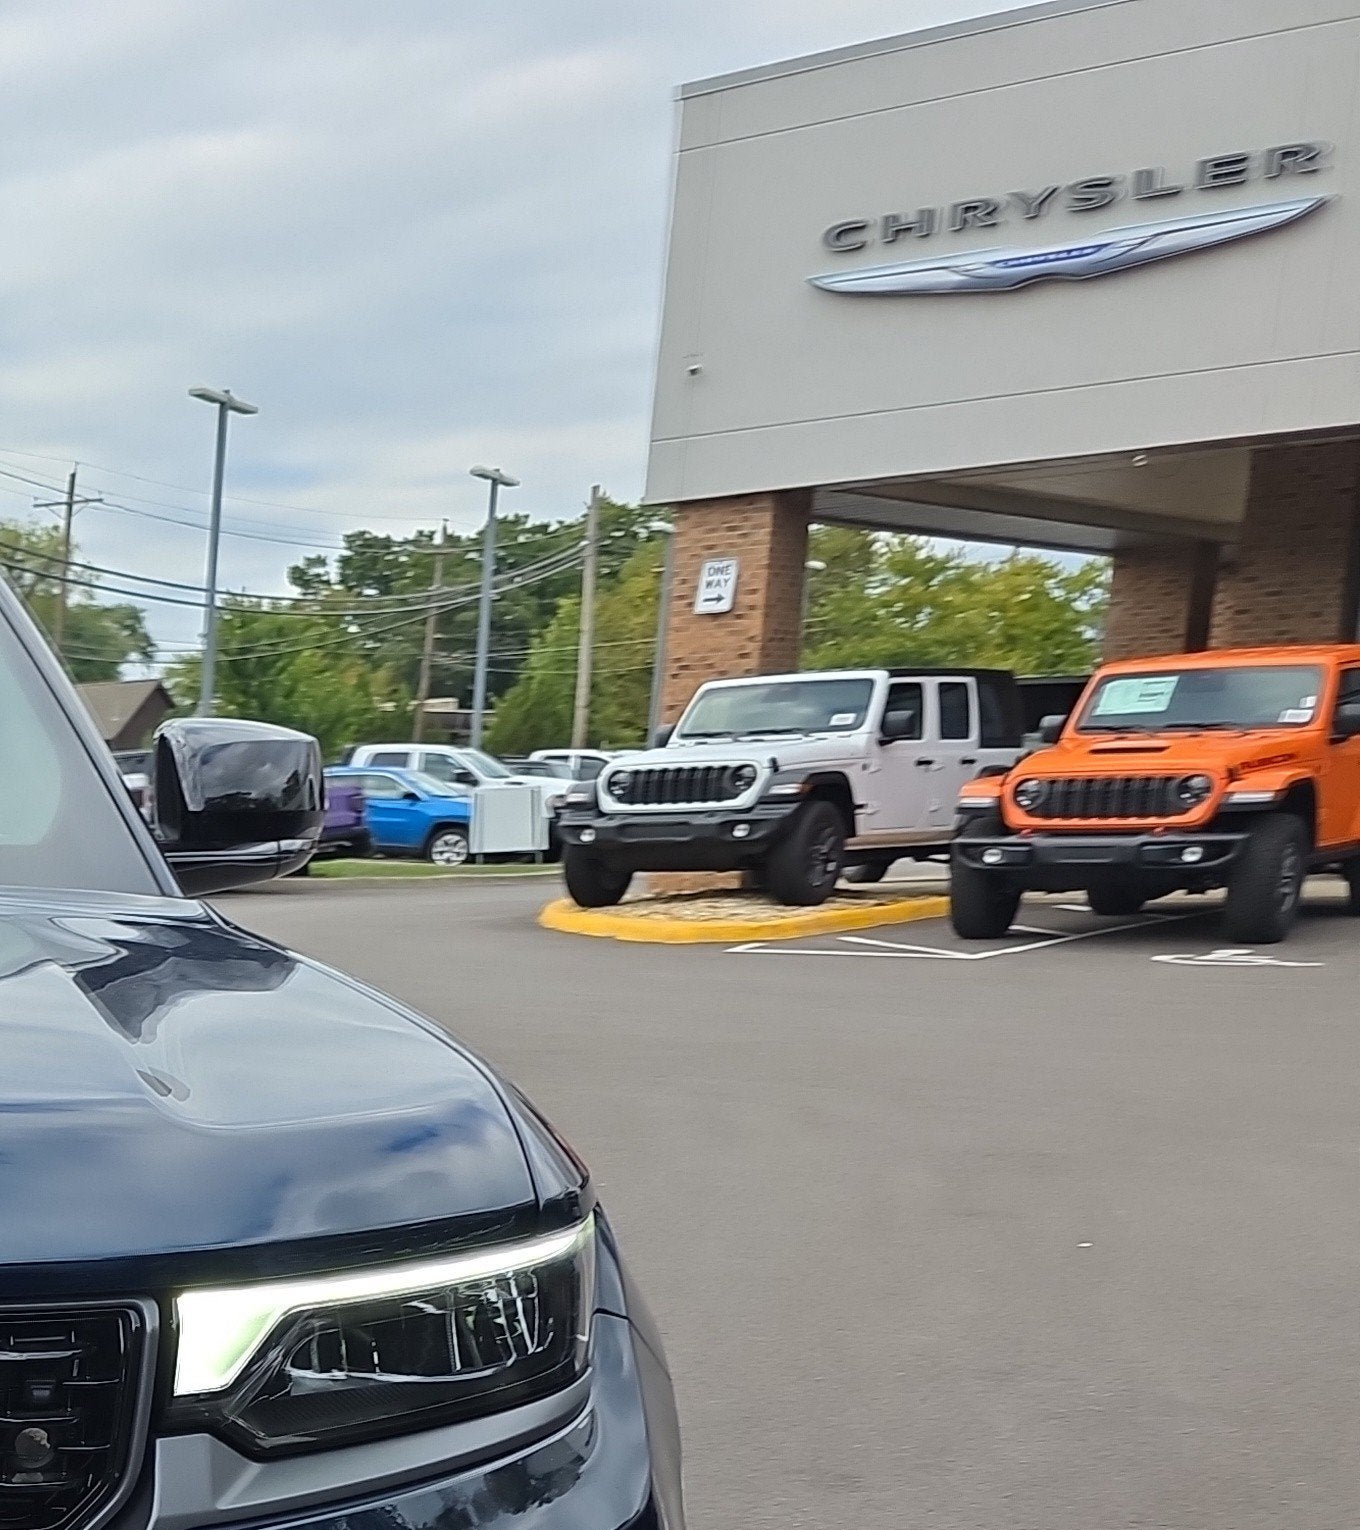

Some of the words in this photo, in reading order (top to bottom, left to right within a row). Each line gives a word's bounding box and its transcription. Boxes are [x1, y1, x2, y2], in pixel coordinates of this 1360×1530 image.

[822, 140, 1330, 252] CHRYSLER
[707, 564, 732, 577] ONE
[705, 578, 731, 589] WAY
